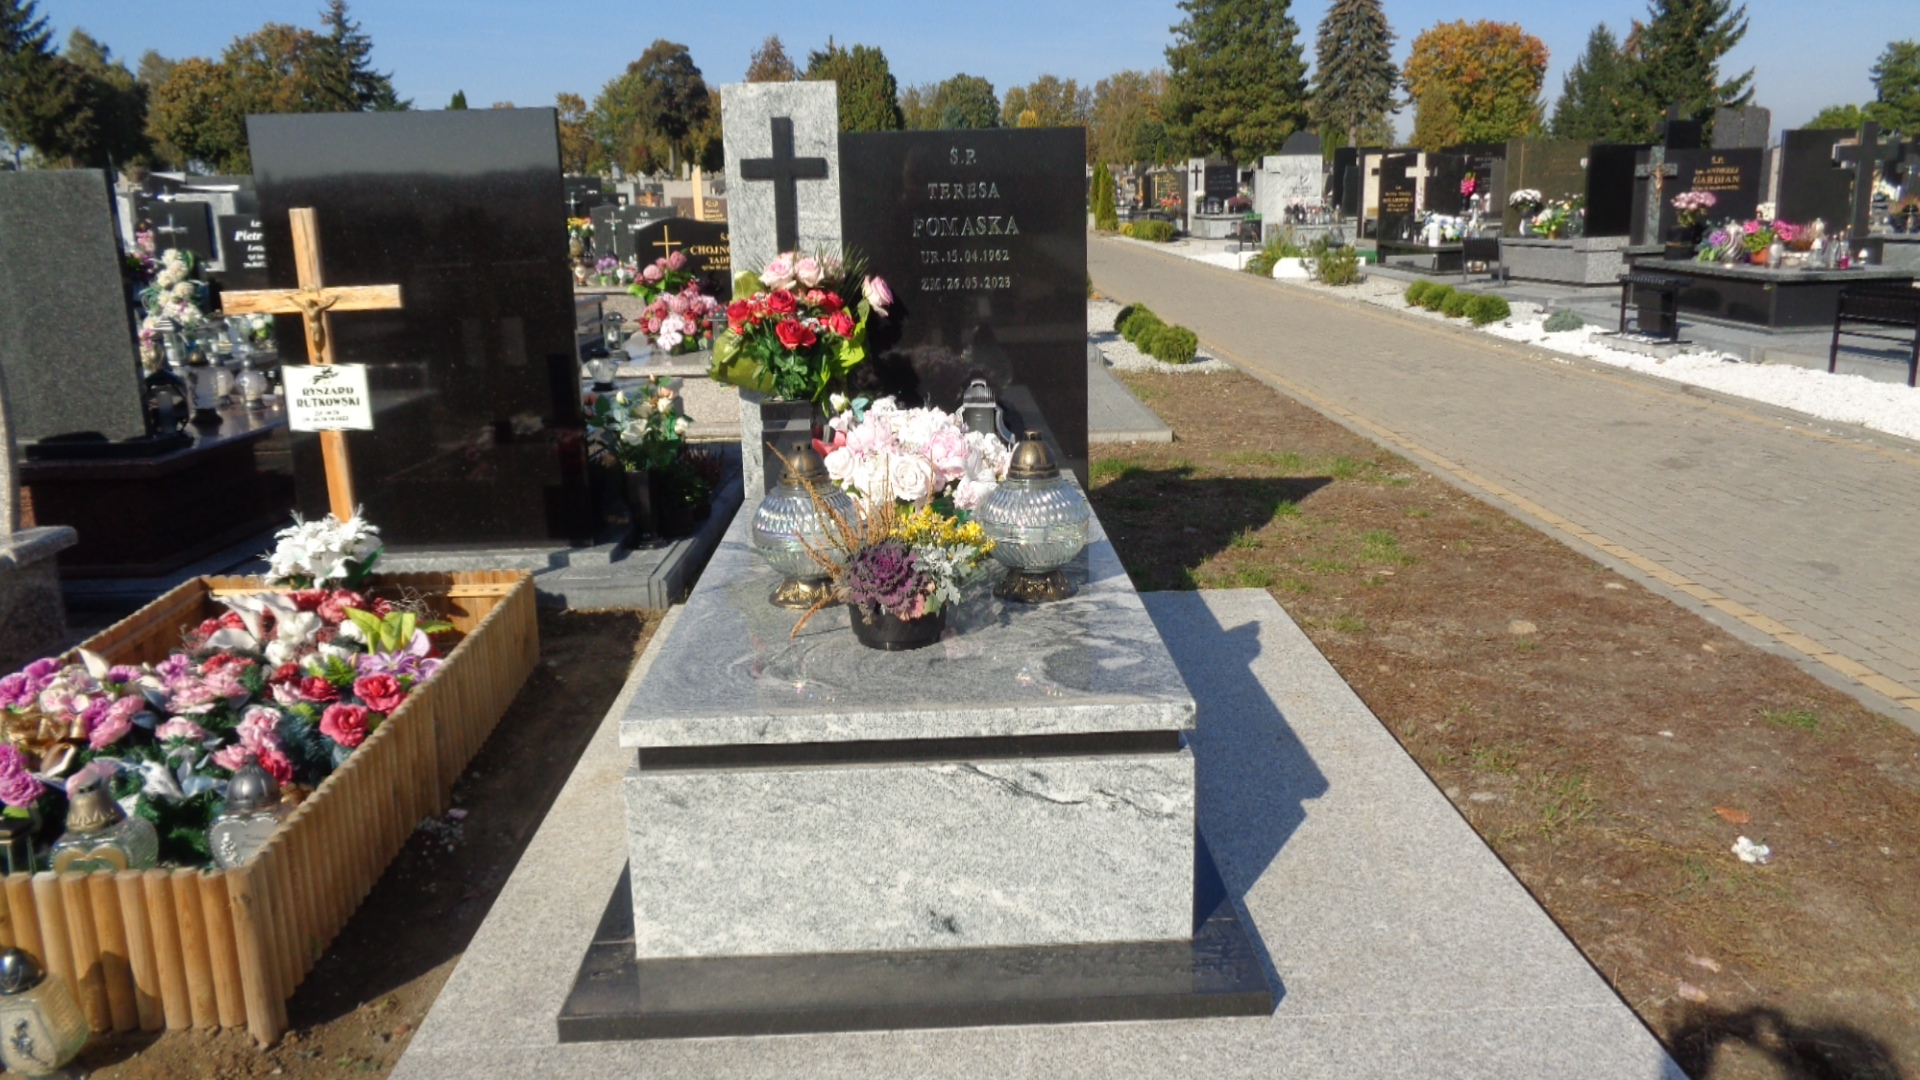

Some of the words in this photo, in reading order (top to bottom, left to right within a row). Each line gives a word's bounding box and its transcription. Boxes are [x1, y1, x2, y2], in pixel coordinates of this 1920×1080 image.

[1693, 175, 1740, 184] GARDIAN
[927, 182, 1001, 200] TERESA
[912, 216, 1020, 238] POMASKA
[296, 397, 360, 408] RUTKOWSKI
